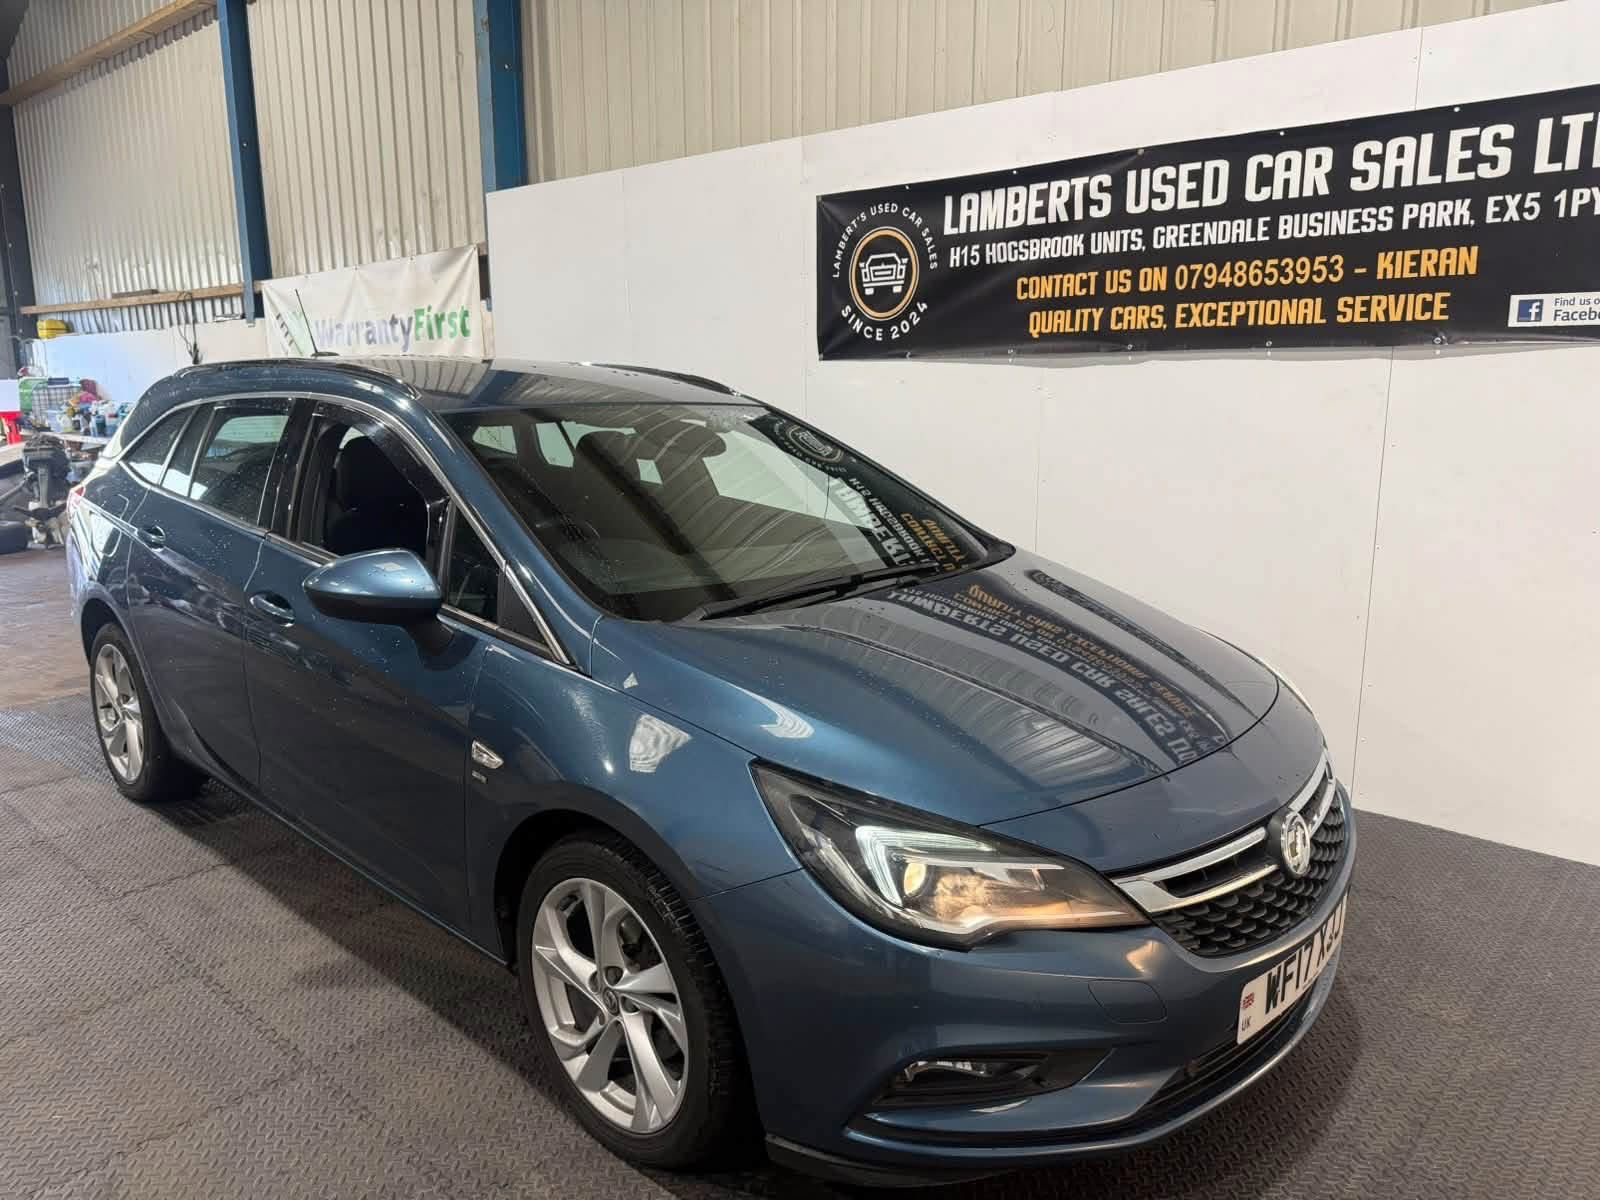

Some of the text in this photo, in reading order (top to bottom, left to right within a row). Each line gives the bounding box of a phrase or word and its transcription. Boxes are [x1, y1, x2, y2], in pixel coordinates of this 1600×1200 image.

[944, 111, 1600, 236] LAMBERTS USED CAR SALES LT
[832, 202, 938, 278] LAMBERT'S USED CAR SALES
[950, 244, 980, 268] H15
[986, 234, 1085, 264] HOGSBROOK
[1091, 228, 1146, 254] UNITS,
[1153, 216, 1270, 249] GREENDALE
[1277, 206, 1394, 240] BUSINESS
[1402, 198, 1476, 230] PARK,
[1485, 192, 1541, 224] EX5
[1017, 271, 1098, 300] CONTACT
[1105, 269, 1132, 294] US
[1139, 266, 1168, 292] ON
[1175, 254, 1345, 291] 07948653953
[1376, 245, 1479, 280] KIERAN
[841, 301, 928, 341] SINCE 2024
[1029, 292, 1451, 339] QUALITY CARS, EXCEPTIONAL SERVICE
[1554, 296, 1576, 306] Find
[1579, 298, 1591, 306] us
[1554, 307, 1600, 321] Faceb
[315, 304, 471, 352] WarrantyFirst
[1265, 934, 1314, 1014] WF17
[1241, 1016, 1250, 1032] UK
